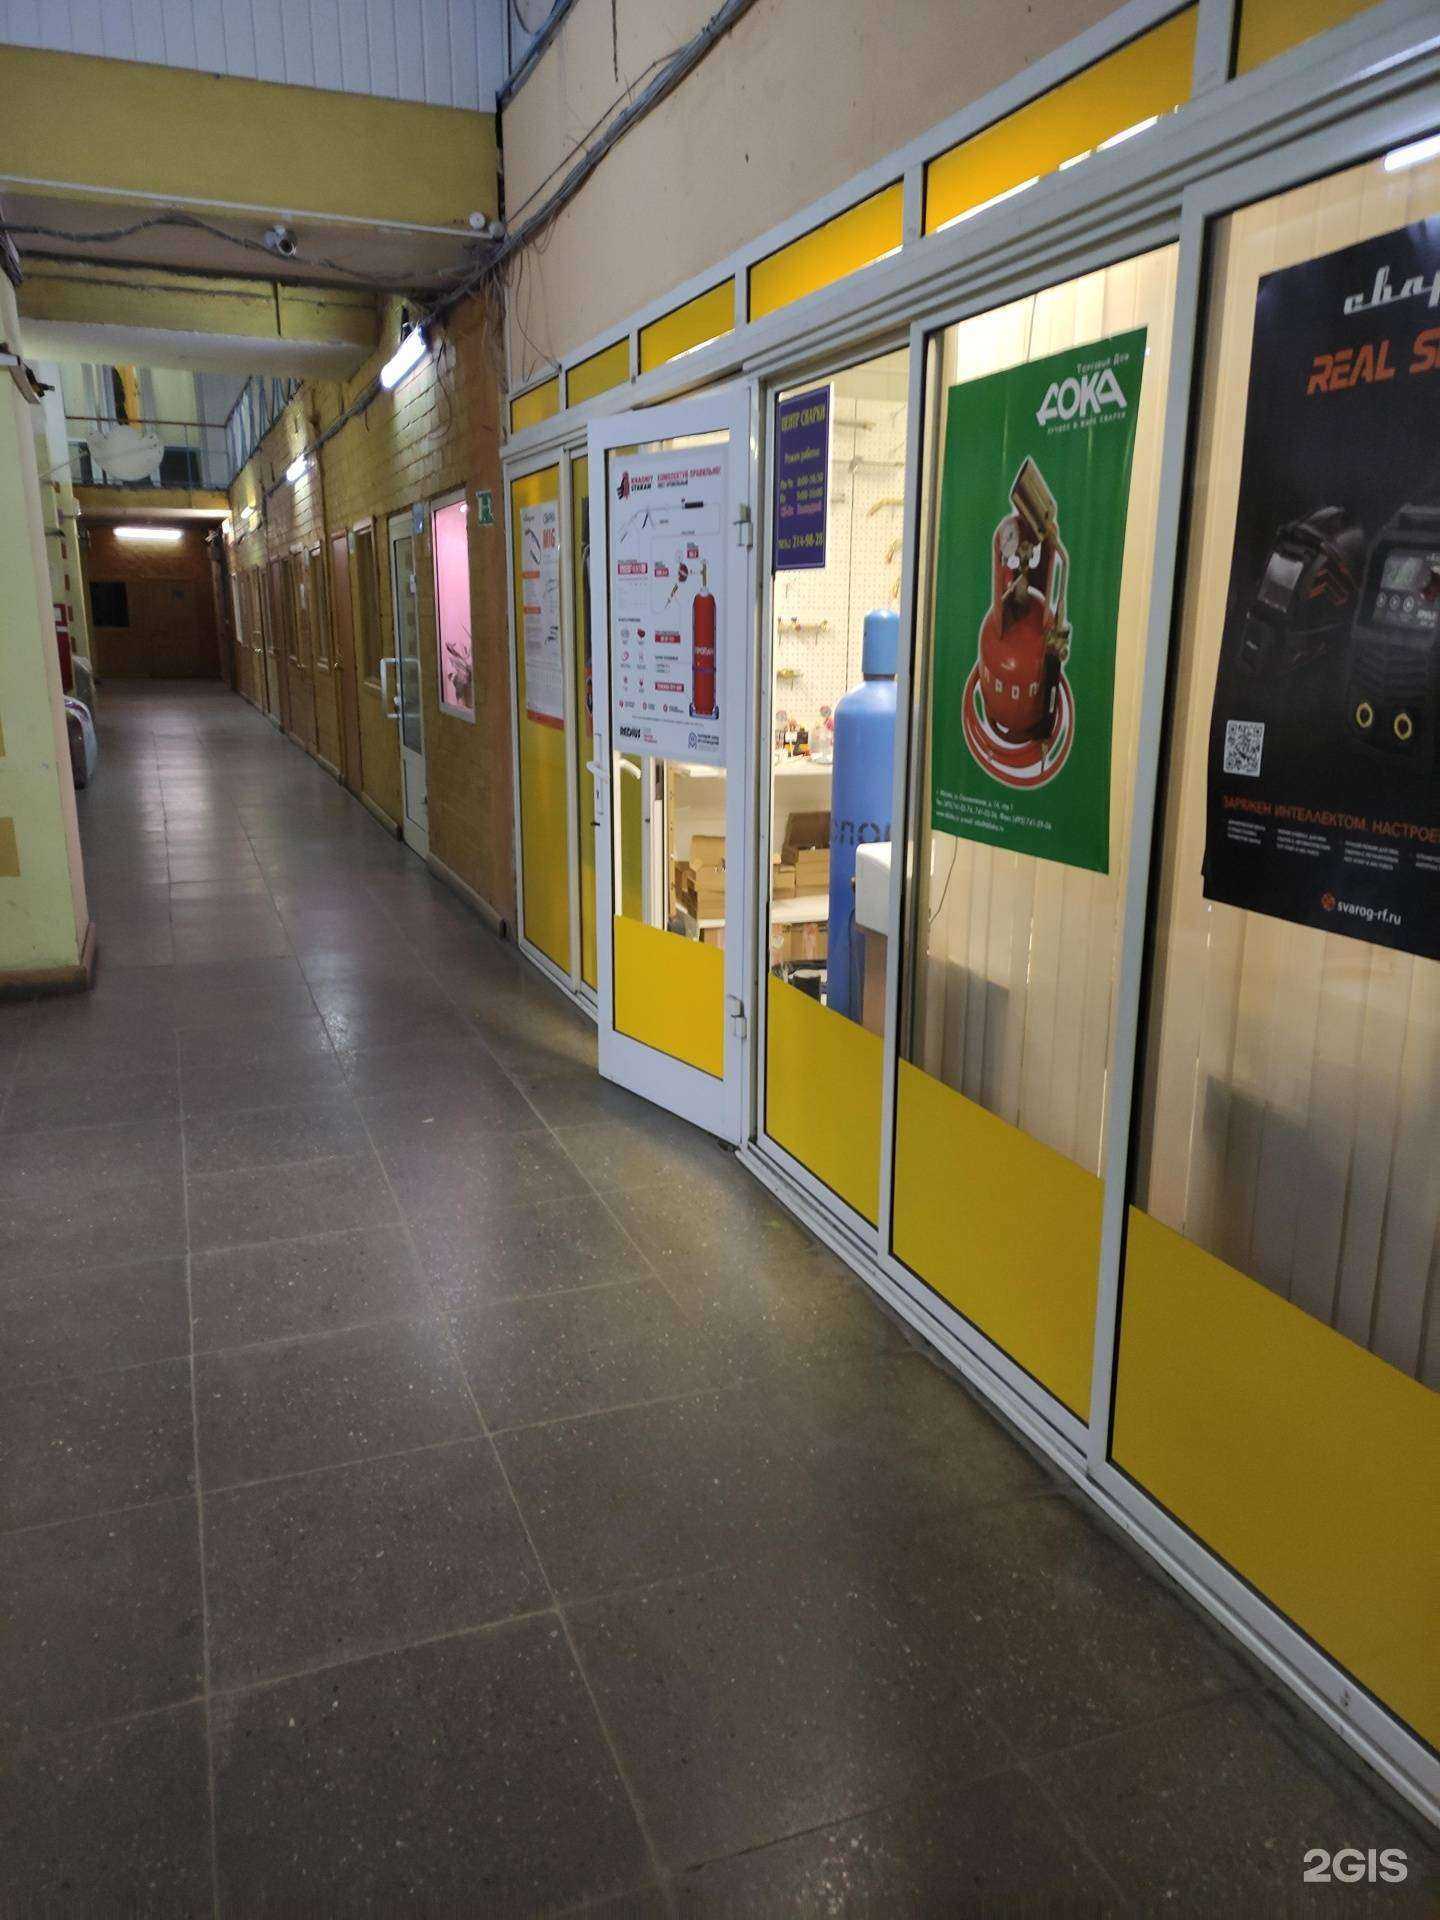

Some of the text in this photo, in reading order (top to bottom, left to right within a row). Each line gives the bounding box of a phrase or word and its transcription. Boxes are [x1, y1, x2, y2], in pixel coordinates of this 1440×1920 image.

[1306, 326, 1440, 396] REAL S
[1035, 369, 1128, 427] ДОКА
[1337, 899, 1402, 925] svarog-rf.ru
